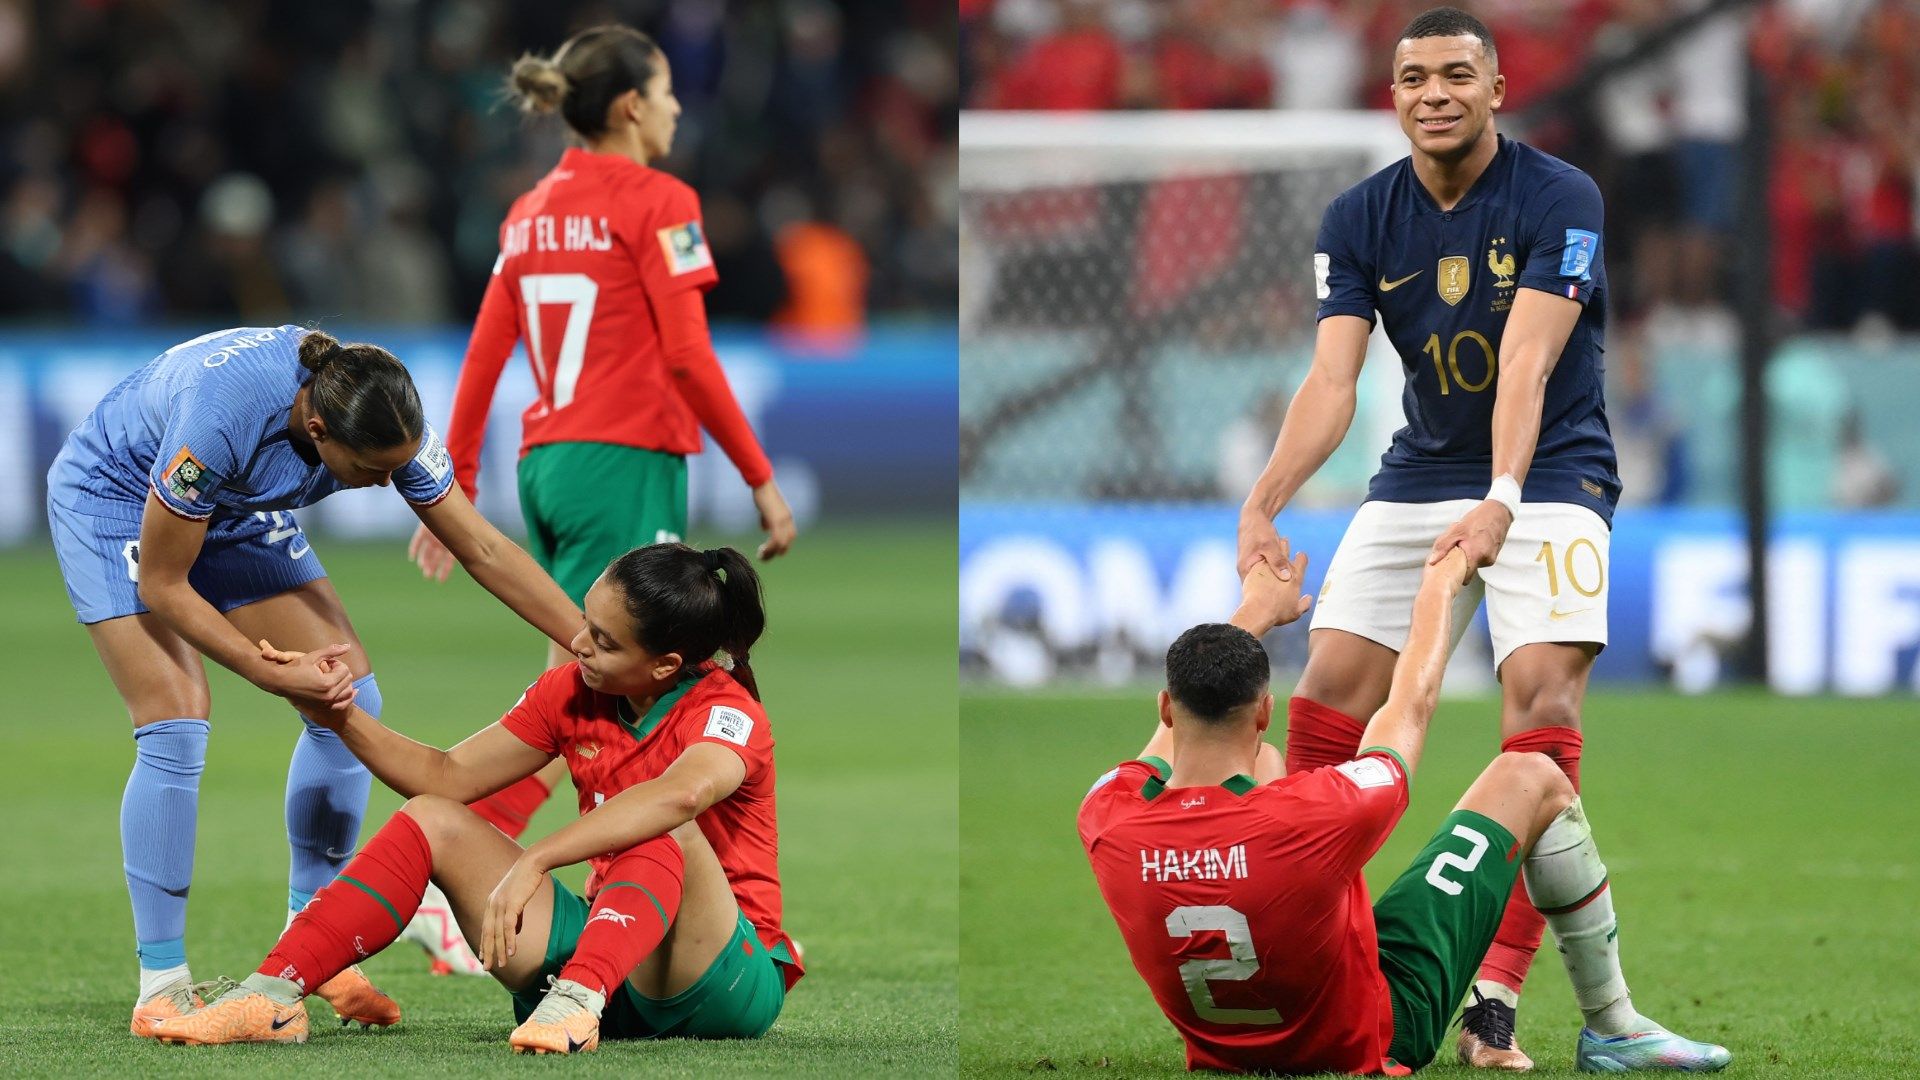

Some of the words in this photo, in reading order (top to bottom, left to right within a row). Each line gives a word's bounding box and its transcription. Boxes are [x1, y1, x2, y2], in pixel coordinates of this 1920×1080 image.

[535, 215, 559, 252] EL
[564, 215, 612, 252] HAJ
[519, 273, 599, 412] 17
[1422, 330, 1496, 395] 10
[253, 509, 302, 544] 2
[1534, 538, 1604, 598] 10
[1652, 535, 1920, 694] FIF
[1140, 844, 1248, 882] HAKIMI
[1425, 824, 1490, 896] 2
[1165, 905, 1284, 1025] 2
